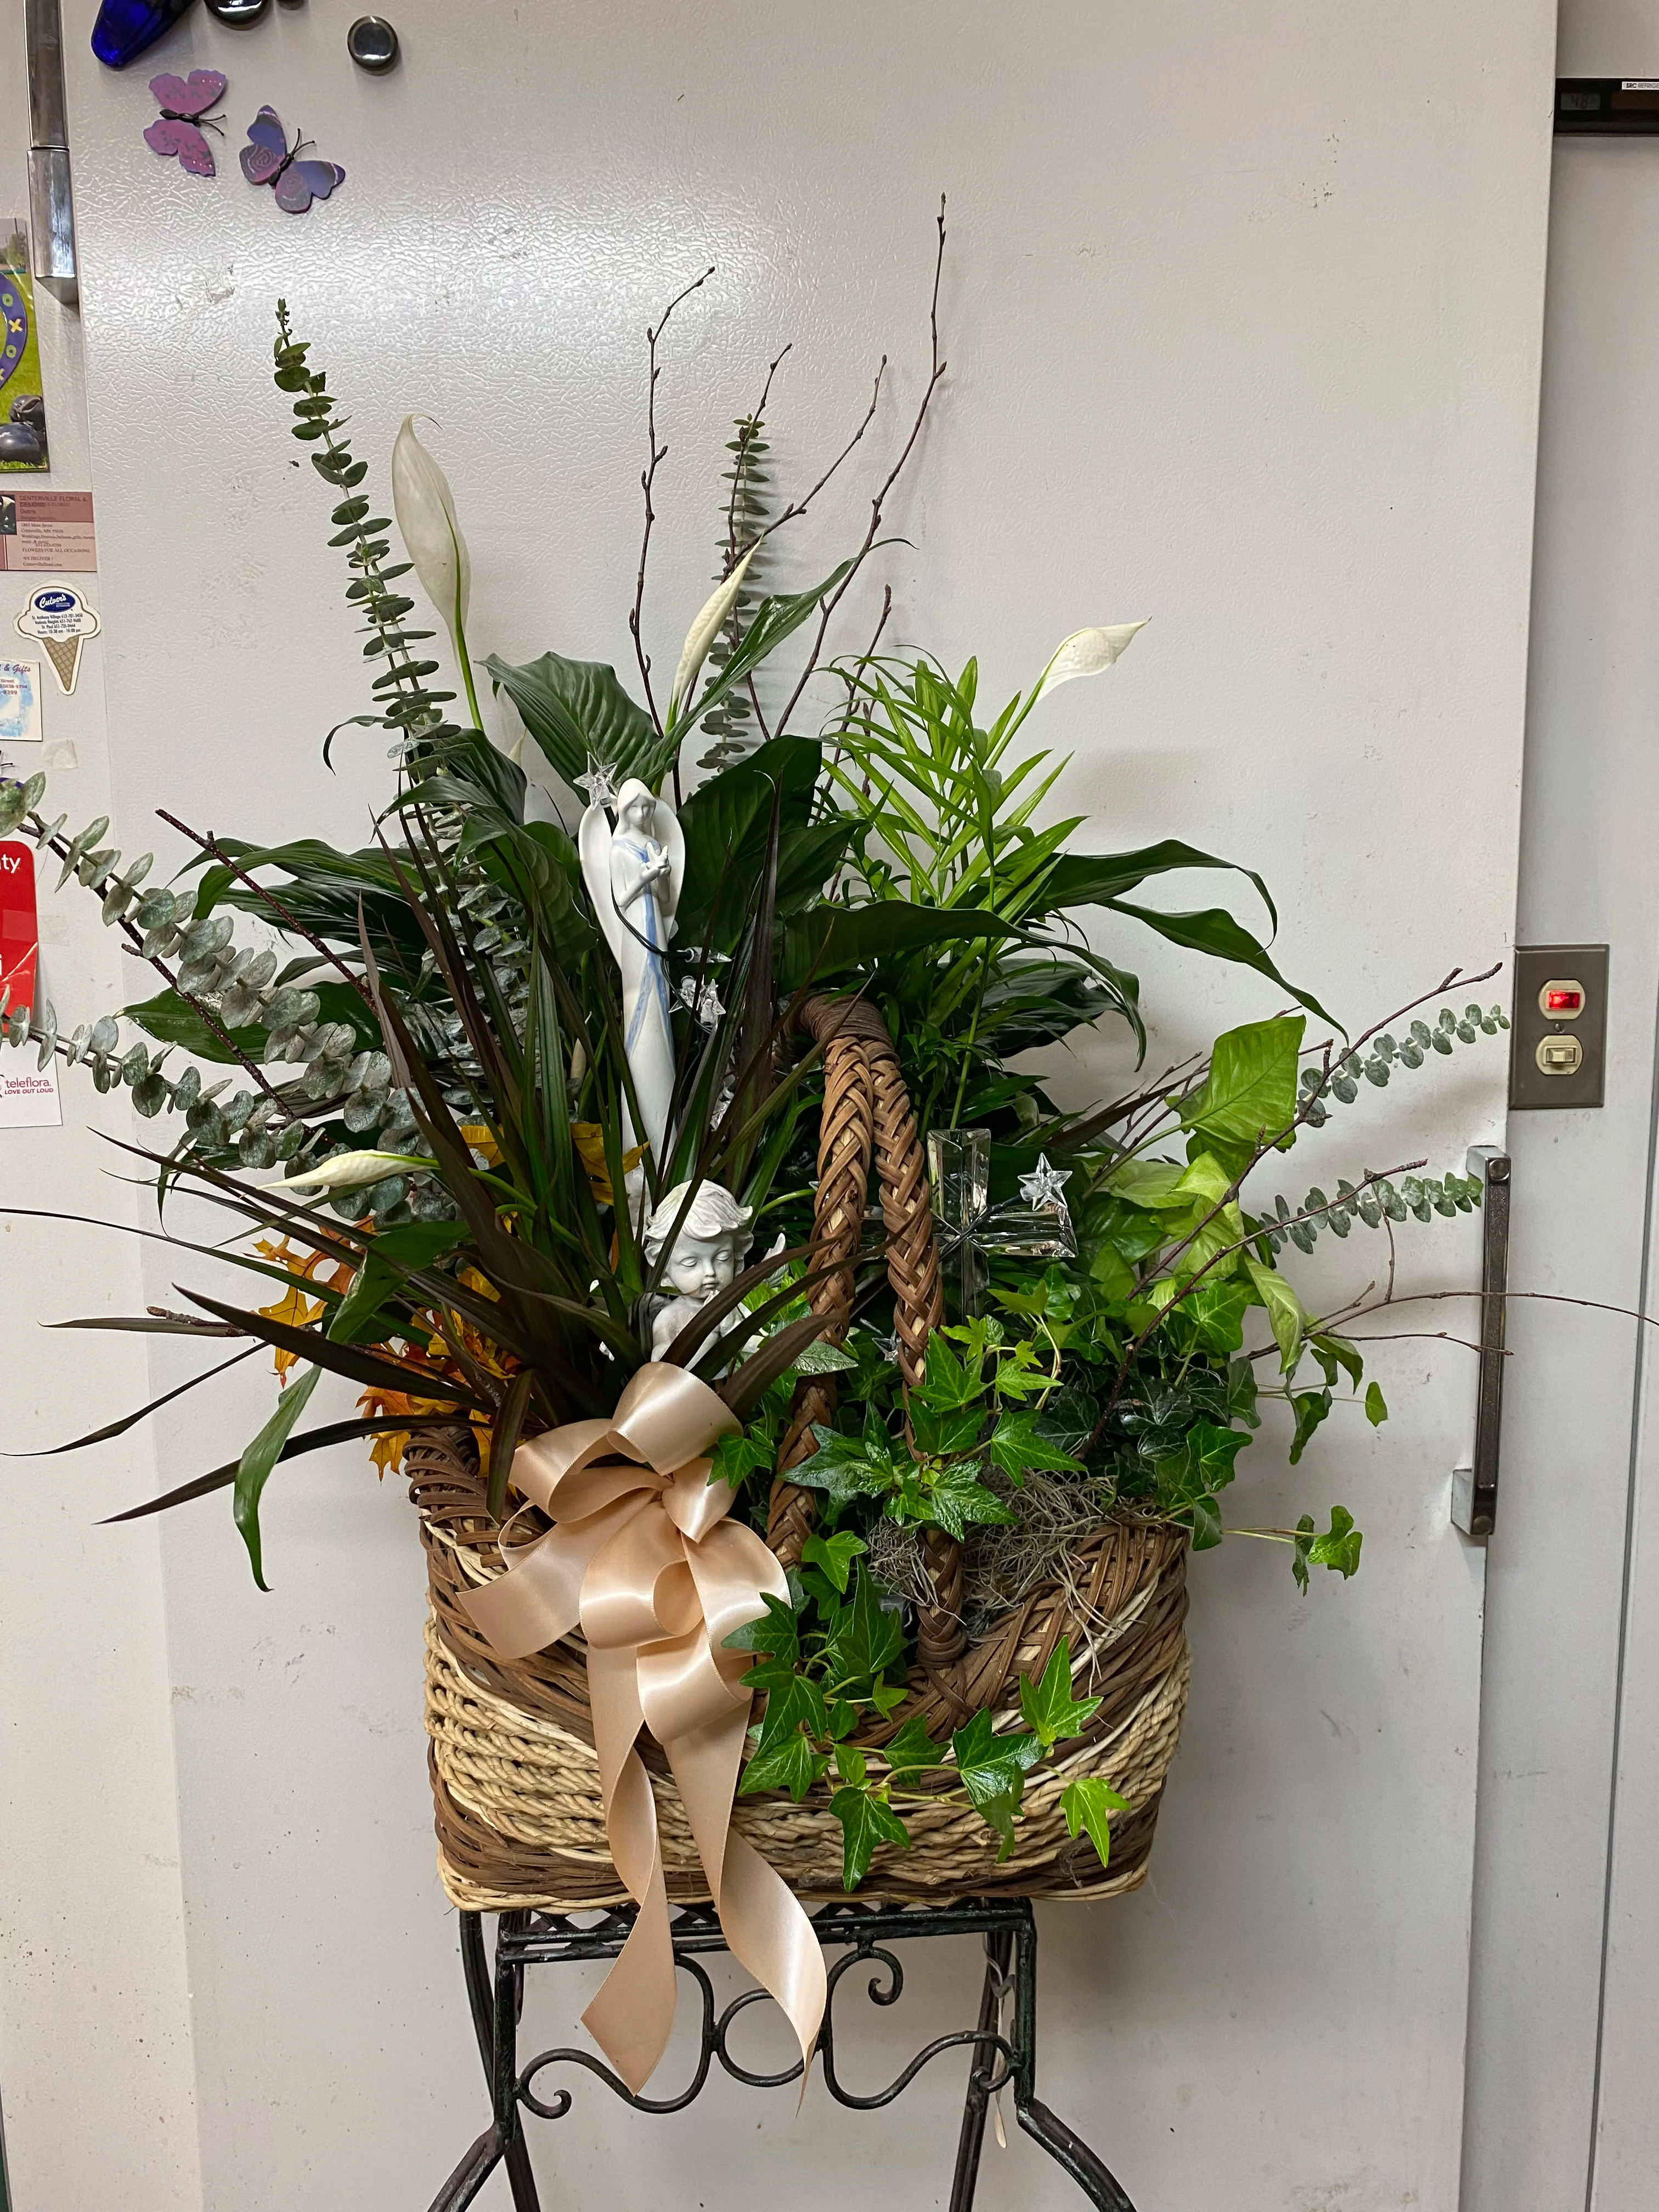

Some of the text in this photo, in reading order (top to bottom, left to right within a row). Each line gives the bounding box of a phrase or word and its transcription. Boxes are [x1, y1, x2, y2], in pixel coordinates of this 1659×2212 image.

[39, 593, 67, 608] Culver's
[12, 664, 31, 675] Gifts
[0, 854, 21, 873] ty
